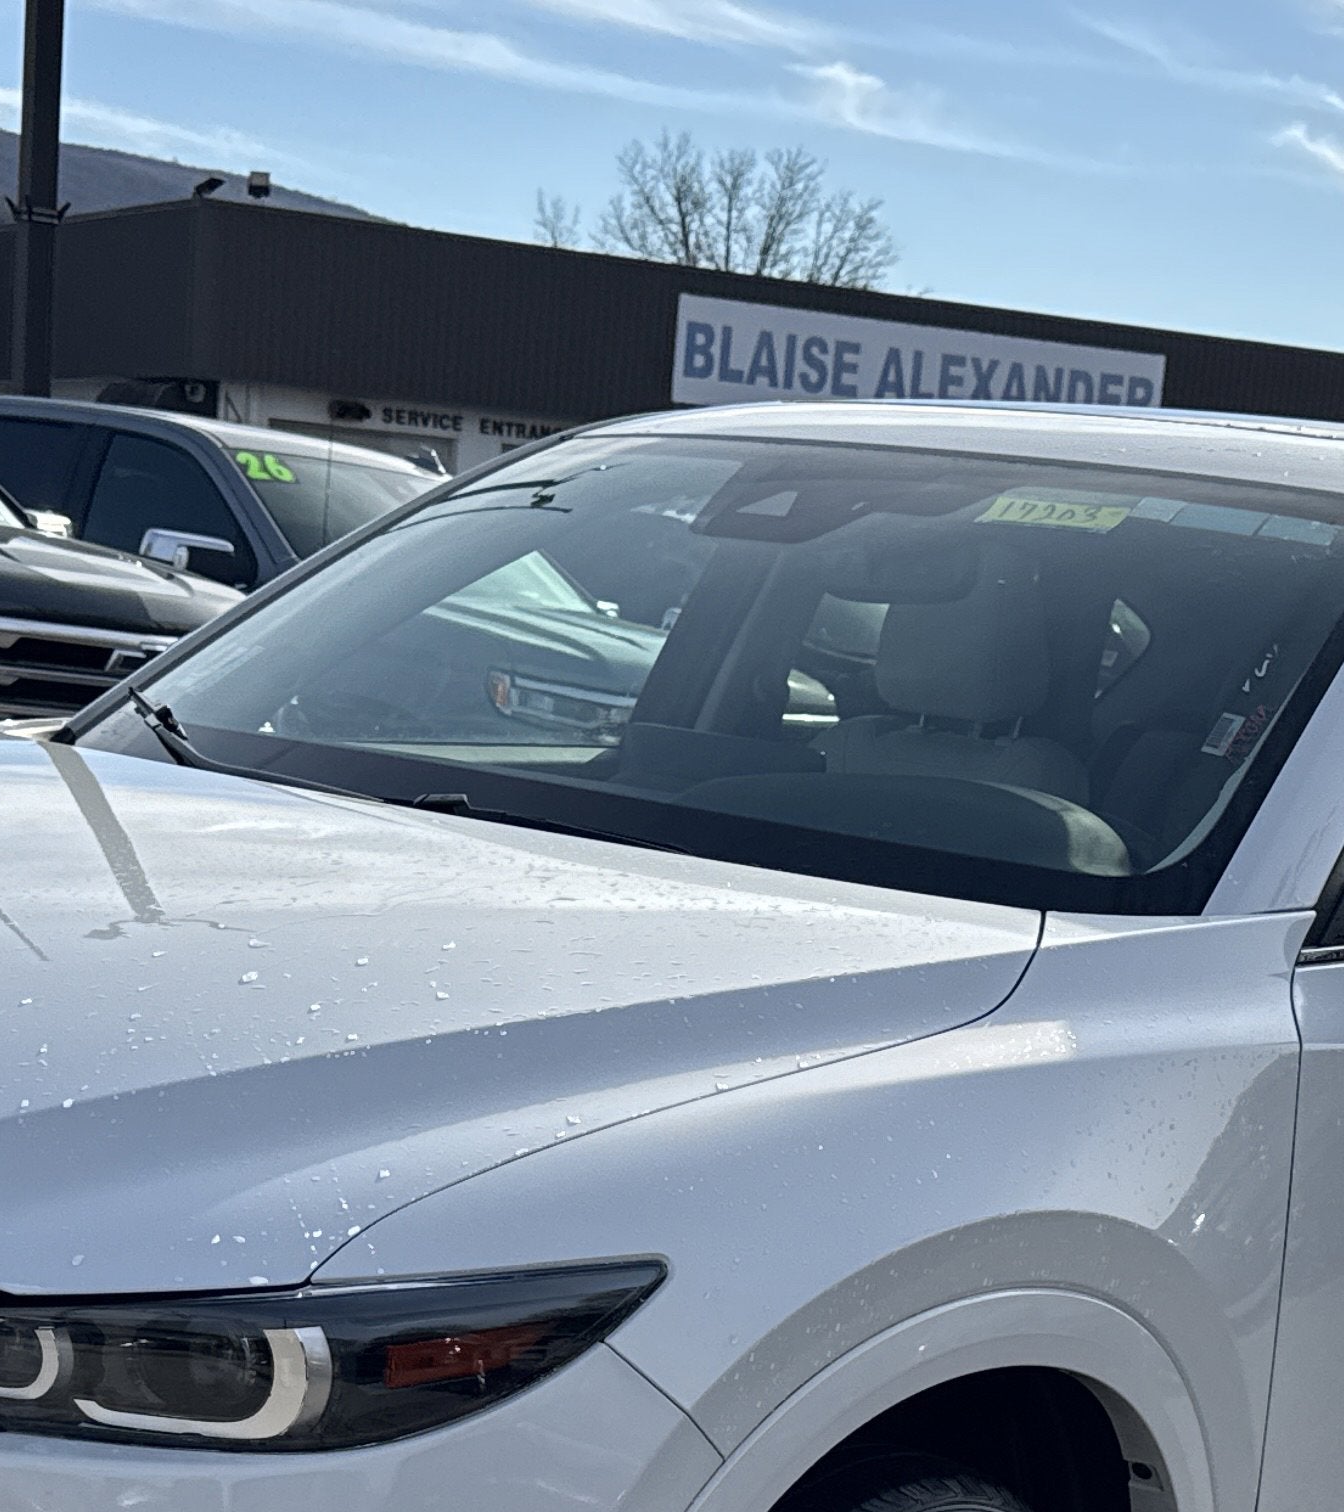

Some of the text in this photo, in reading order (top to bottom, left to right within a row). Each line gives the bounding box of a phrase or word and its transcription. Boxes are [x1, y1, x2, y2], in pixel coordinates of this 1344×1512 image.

[683, 319, 1155, 407] BLAISE ALEXANDER
[382, 407, 562, 439] SERVICE ENTRAN
[236, 451, 296, 484] 26
